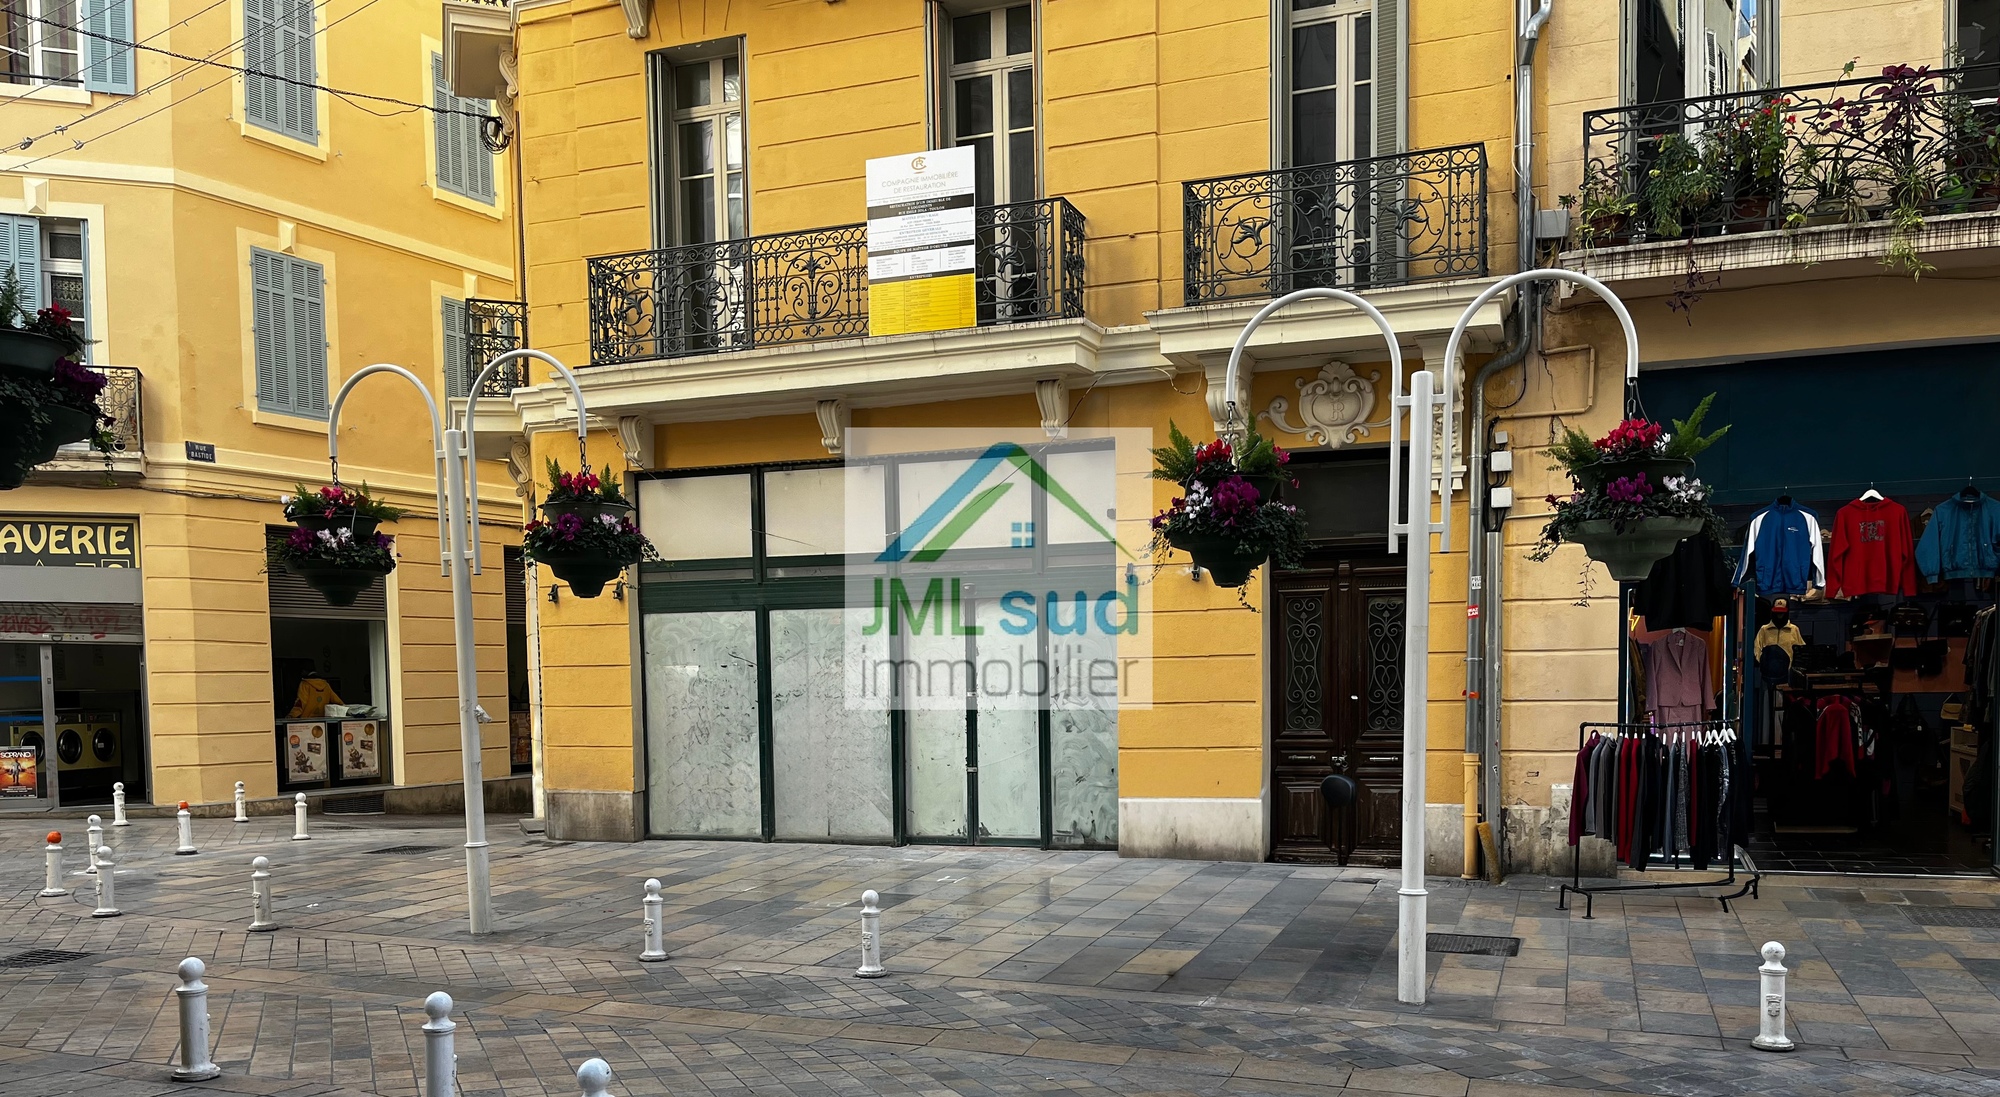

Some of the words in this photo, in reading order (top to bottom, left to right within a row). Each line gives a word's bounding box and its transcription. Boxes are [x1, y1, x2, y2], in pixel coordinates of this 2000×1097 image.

[881, 176, 920, 188] COMPAGNIE
[921, 171, 959, 182] IMMOBILIÈRE
[903, 181, 946, 193] RESTAURATION
[191, 451, 212, 459] BASTIDE
[0, 524, 131, 555] AVERIE
